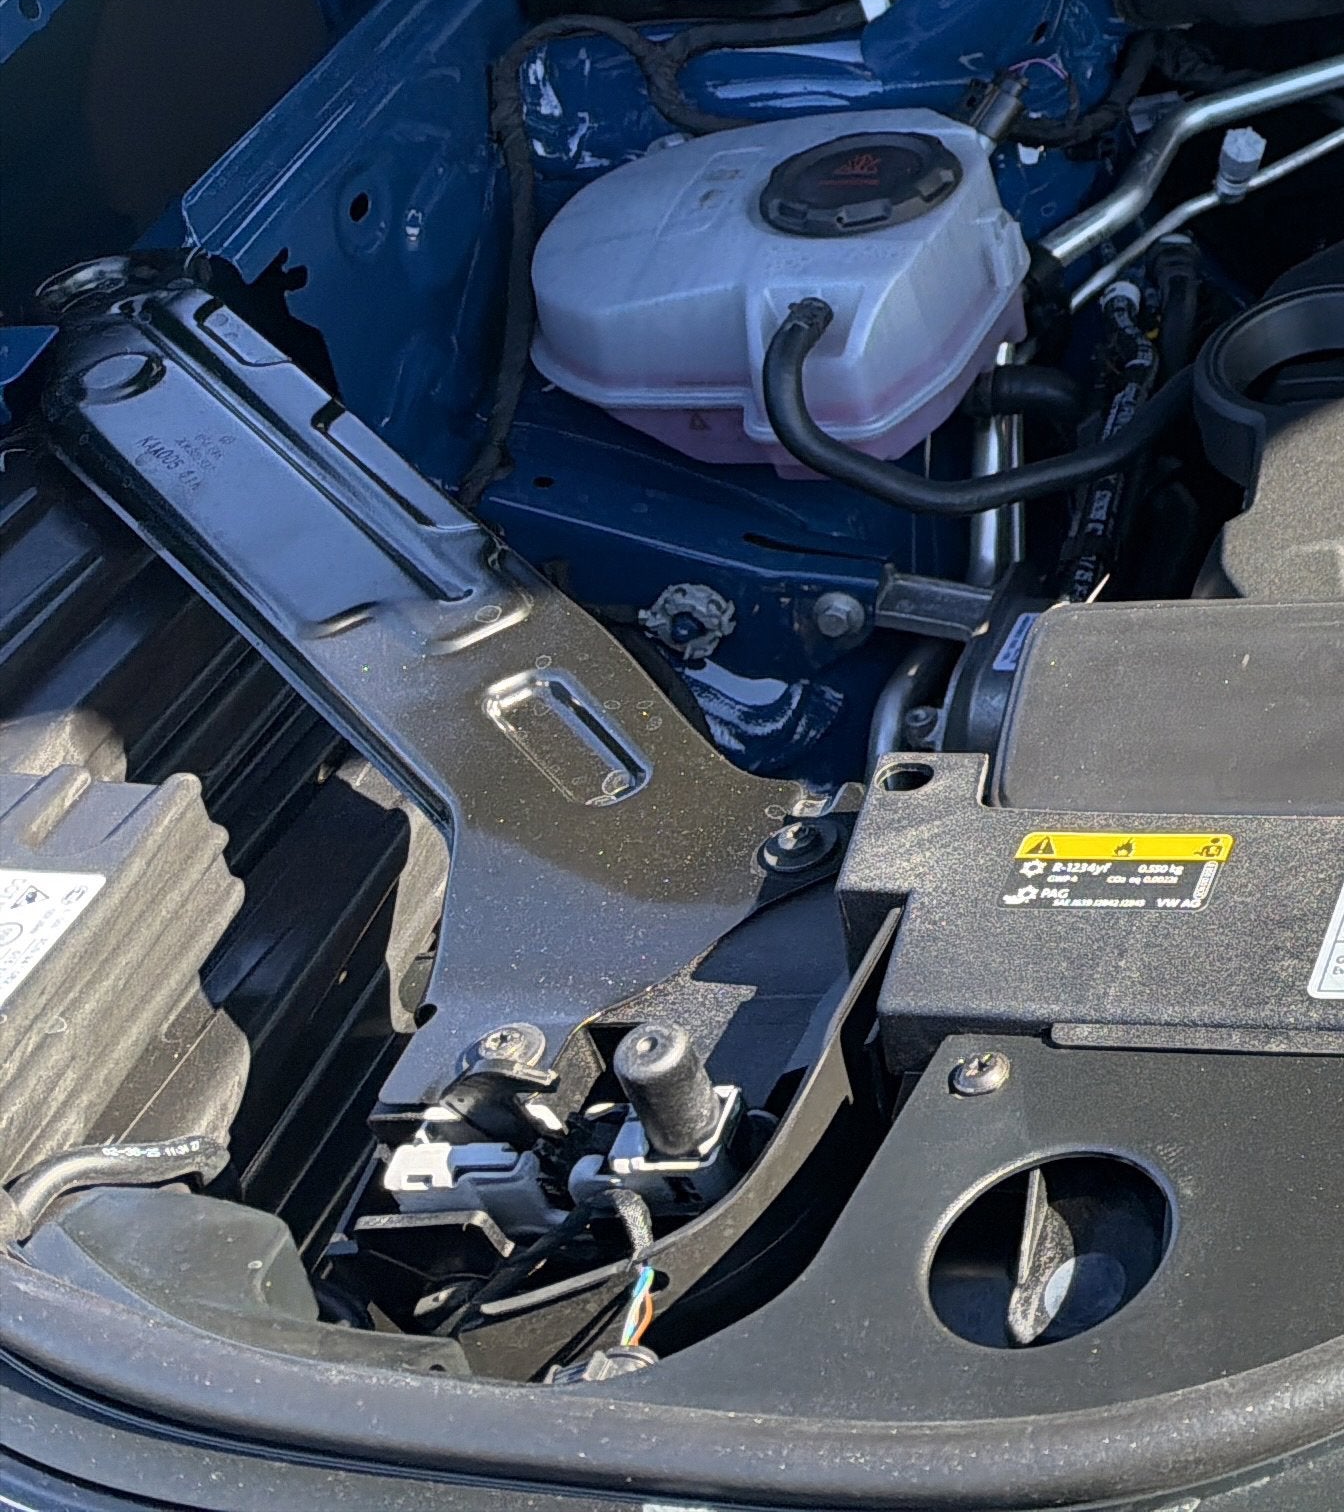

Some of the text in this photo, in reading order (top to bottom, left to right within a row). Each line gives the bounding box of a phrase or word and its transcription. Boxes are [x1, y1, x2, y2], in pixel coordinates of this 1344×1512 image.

[1052, 862, 1112, 876] R-1234yf
[1169, 864, 1185, 876] kg
[1040, 887, 1070, 899] PAG
[1156, 898, 1181, 908] VW
[1180, 898, 1203, 908] AG
